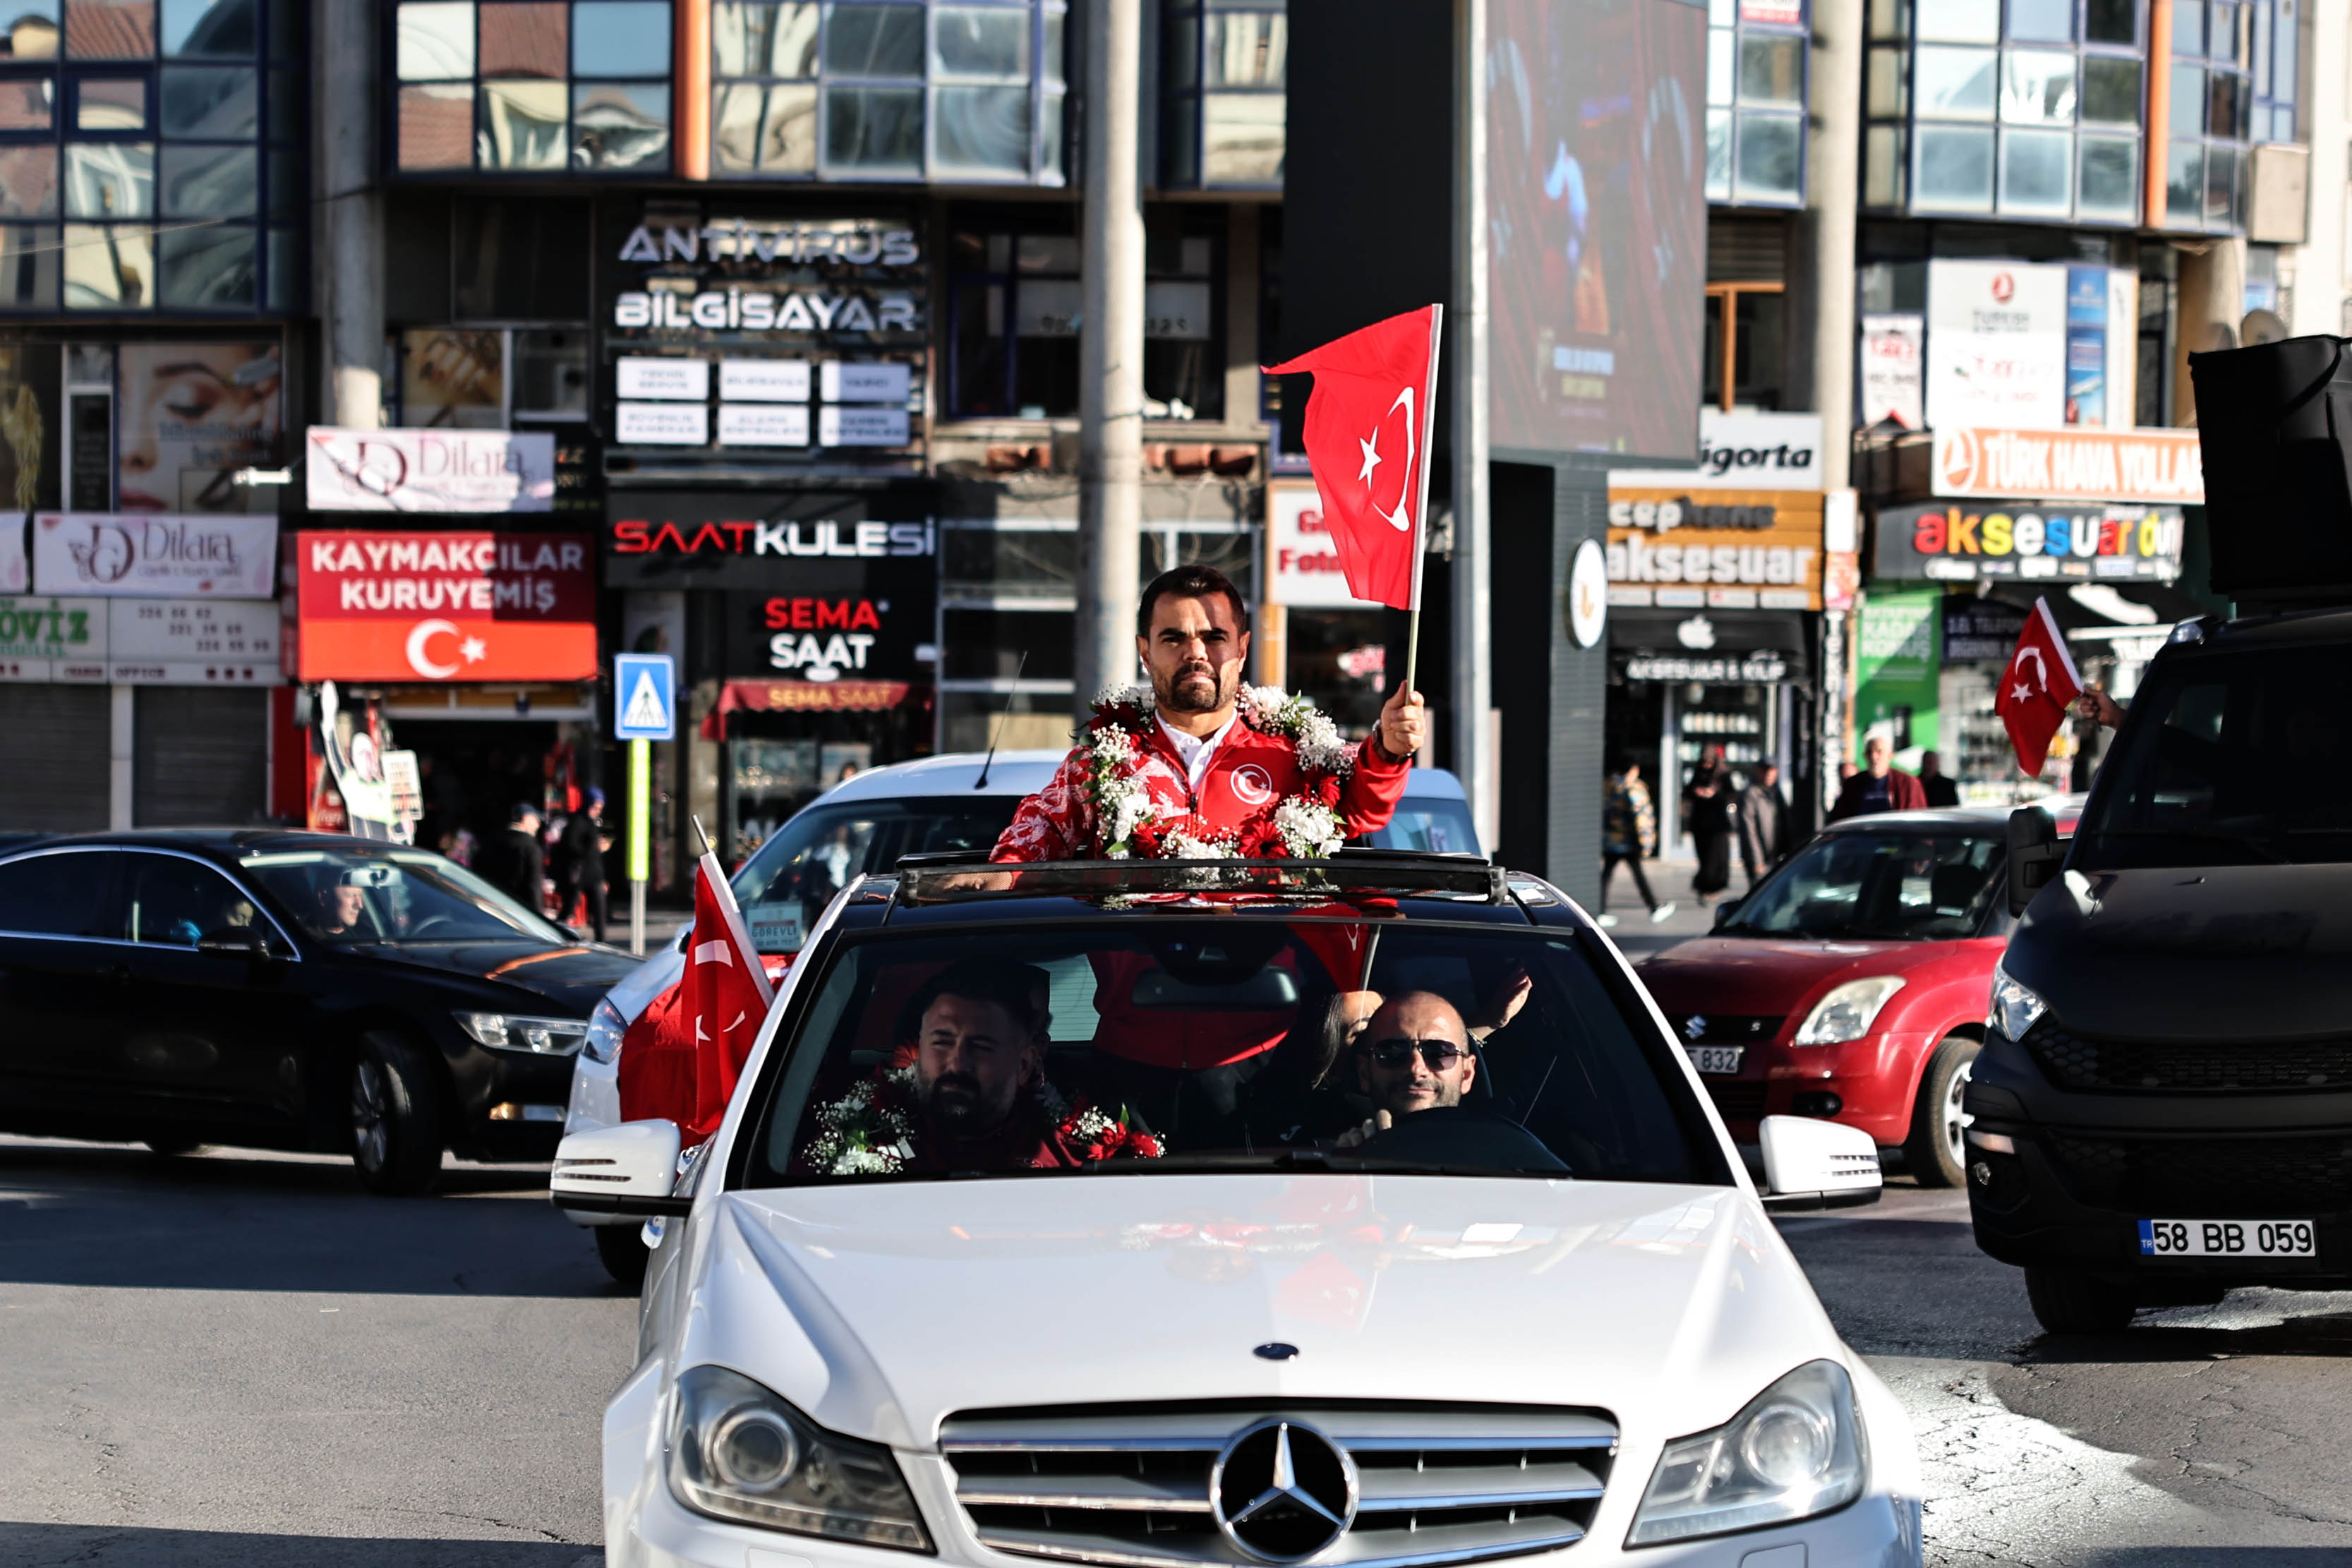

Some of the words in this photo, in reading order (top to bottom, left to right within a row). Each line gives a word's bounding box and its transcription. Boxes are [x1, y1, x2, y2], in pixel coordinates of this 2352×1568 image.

[615, 284, 917, 331] BİLGİSAYAR
[1985, 431, 2049, 490] TÜRK
[2051, 438, 2118, 492] HAVA
[143, 522, 234, 563] Dilara
[1914, 506, 2134, 556] aksesuar
[1606, 533, 1816, 584] aksesuar
[341, 574, 556, 613] KURUYEMİŞ
[765, 598, 881, 630] SEMA
[770, 633, 874, 669] SAAT
[768, 688, 833, 706] SEMA
[838, 687, 891, 706] SAAT
[1701, 1049, 1737, 1071] 832
[2141, 1239, 2152, 1249] TR
[2153, 1222, 2189, 1253] 58
[2202, 1223, 2245, 1253] BB
[2257, 1223, 2312, 1253] 059
